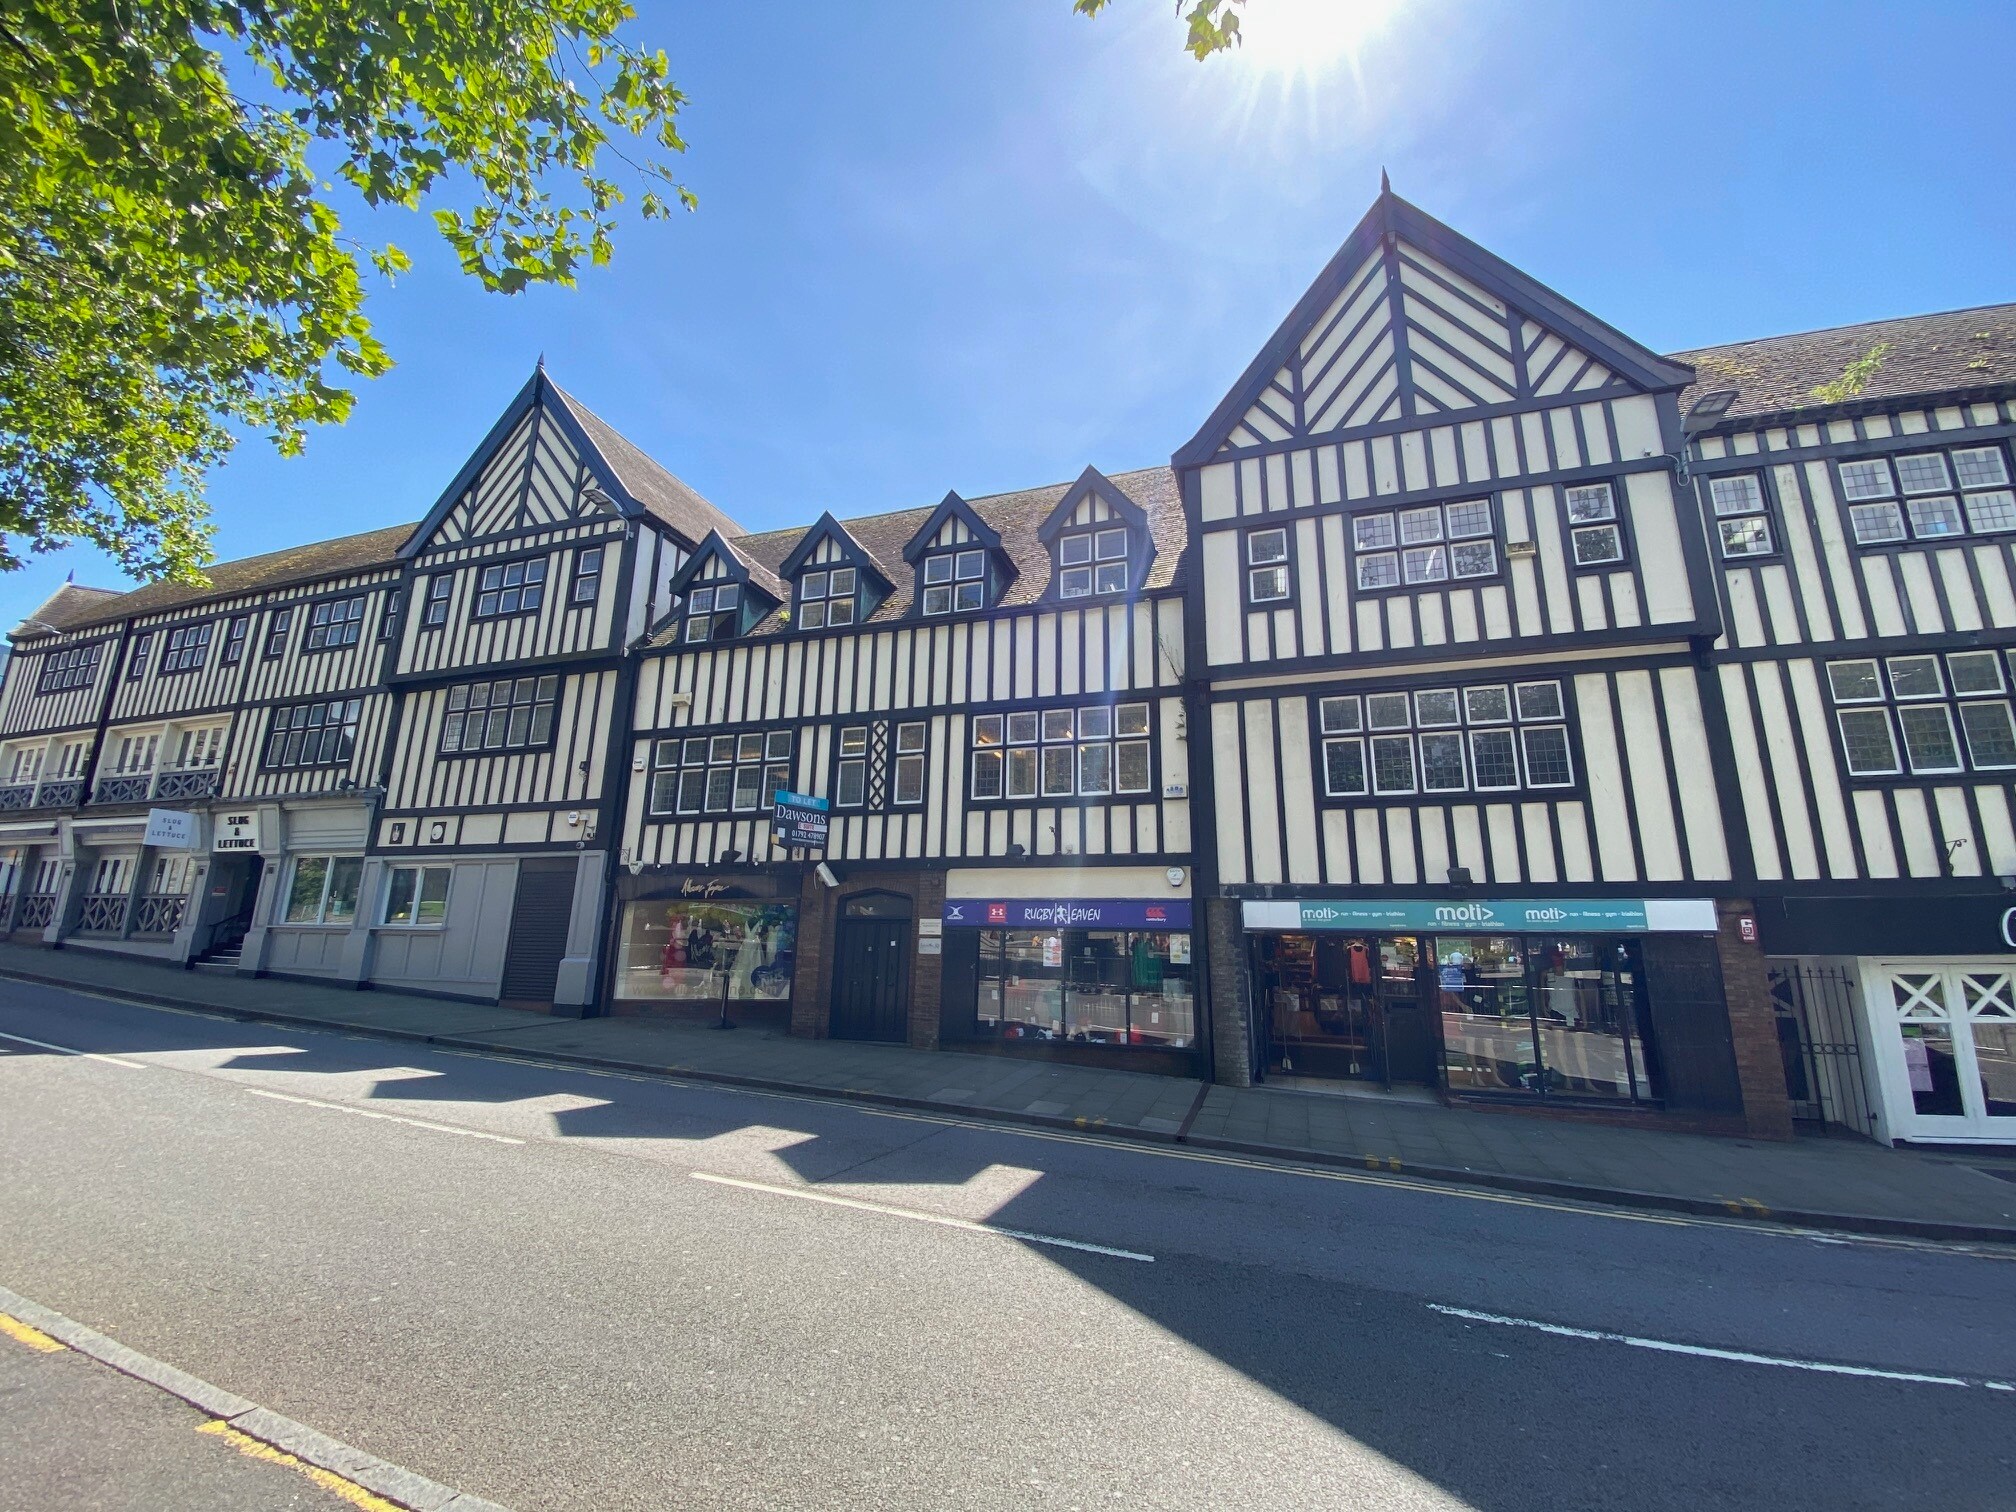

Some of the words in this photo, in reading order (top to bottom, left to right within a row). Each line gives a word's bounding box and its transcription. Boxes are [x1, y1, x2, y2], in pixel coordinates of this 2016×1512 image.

[791, 795, 801, 803] TO
[803, 797, 816, 805] LET
[776, 804, 826, 825] Dawsons
[162, 817, 182, 826] SLUG
[227, 816, 249, 826] SLUG
[151, 830, 186, 840] LETTUCE
[234, 827, 240, 836] &
[791, 830, 807, 839] 01792
[218, 838, 256, 849] LETTUCE
[1024, 907, 1055, 921] RUGBY
